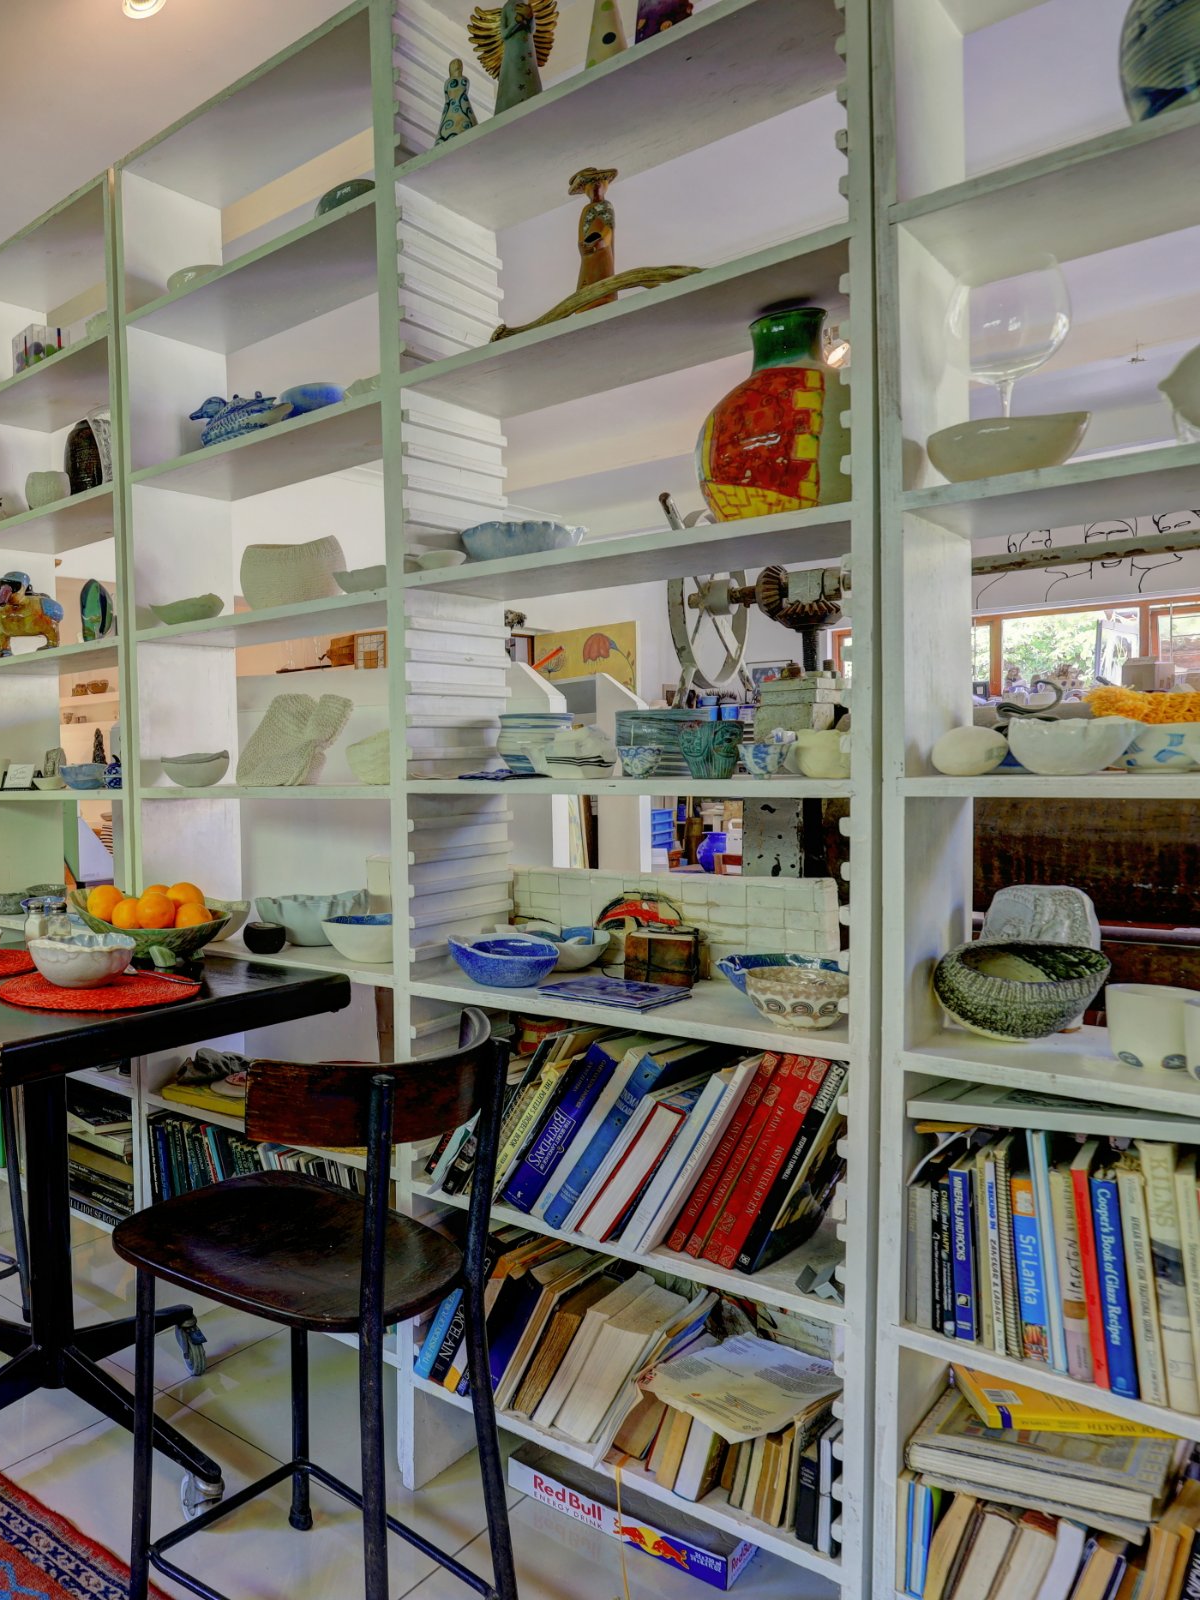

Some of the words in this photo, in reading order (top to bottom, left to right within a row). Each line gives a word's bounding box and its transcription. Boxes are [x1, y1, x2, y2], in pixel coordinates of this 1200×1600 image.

[542, 1078, 553, 1090] THE
[816, 1065, 845, 1114] Samurai
[530, 1090, 547, 1112] POTTER'S
[516, 1111, 533, 1134] PROJECT
[553, 1126, 567, 1144] SECRET
[508, 1131, 521, 1148] BOOK
[528, 1111, 567, 1164] BIRTHDAYS
[737, 1132, 754, 1152] MAN
[541, 1142, 558, 1164] LANGUAGE
[688, 1172, 714, 1217] BYZANTIUM
[708, 1156, 723, 1174] AND
[726, 1120, 742, 1140] EAST
[760, 1144, 785, 1190] FEUDALISM
[751, 1188, 763, 1201] OF
[953, 1176, 963, 1215] MINERALS
[1150, 1158, 1175, 1228] KILNS
[745, 1199, 759, 1216] AGE
[1095, 1188, 1112, 1232] Cooper's
[955, 1215, 963, 1232] AND
[1132, 1216, 1141, 1238] AFRICAN
[956, 1234, 965, 1260] ROCKS
[1019, 1233, 1036, 1257] Sri
[1101, 1234, 1115, 1261] Book
[1102, 1261, 1118, 1274] of
[1021, 1258, 1040, 1305] Lanka
[1104, 1274, 1120, 1303] Glaze
[439, 1304, 464, 1361] ORCELAIN
[1107, 1304, 1122, 1346] Recipes
[1086, 1421, 1135, 1432] WEALTH
[534, 1474, 566, 1503] Red
[569, 1492, 602, 1521] Bull
[534, 1491, 570, 1513] ENERGY
[574, 1512, 603, 1530] DRINK
